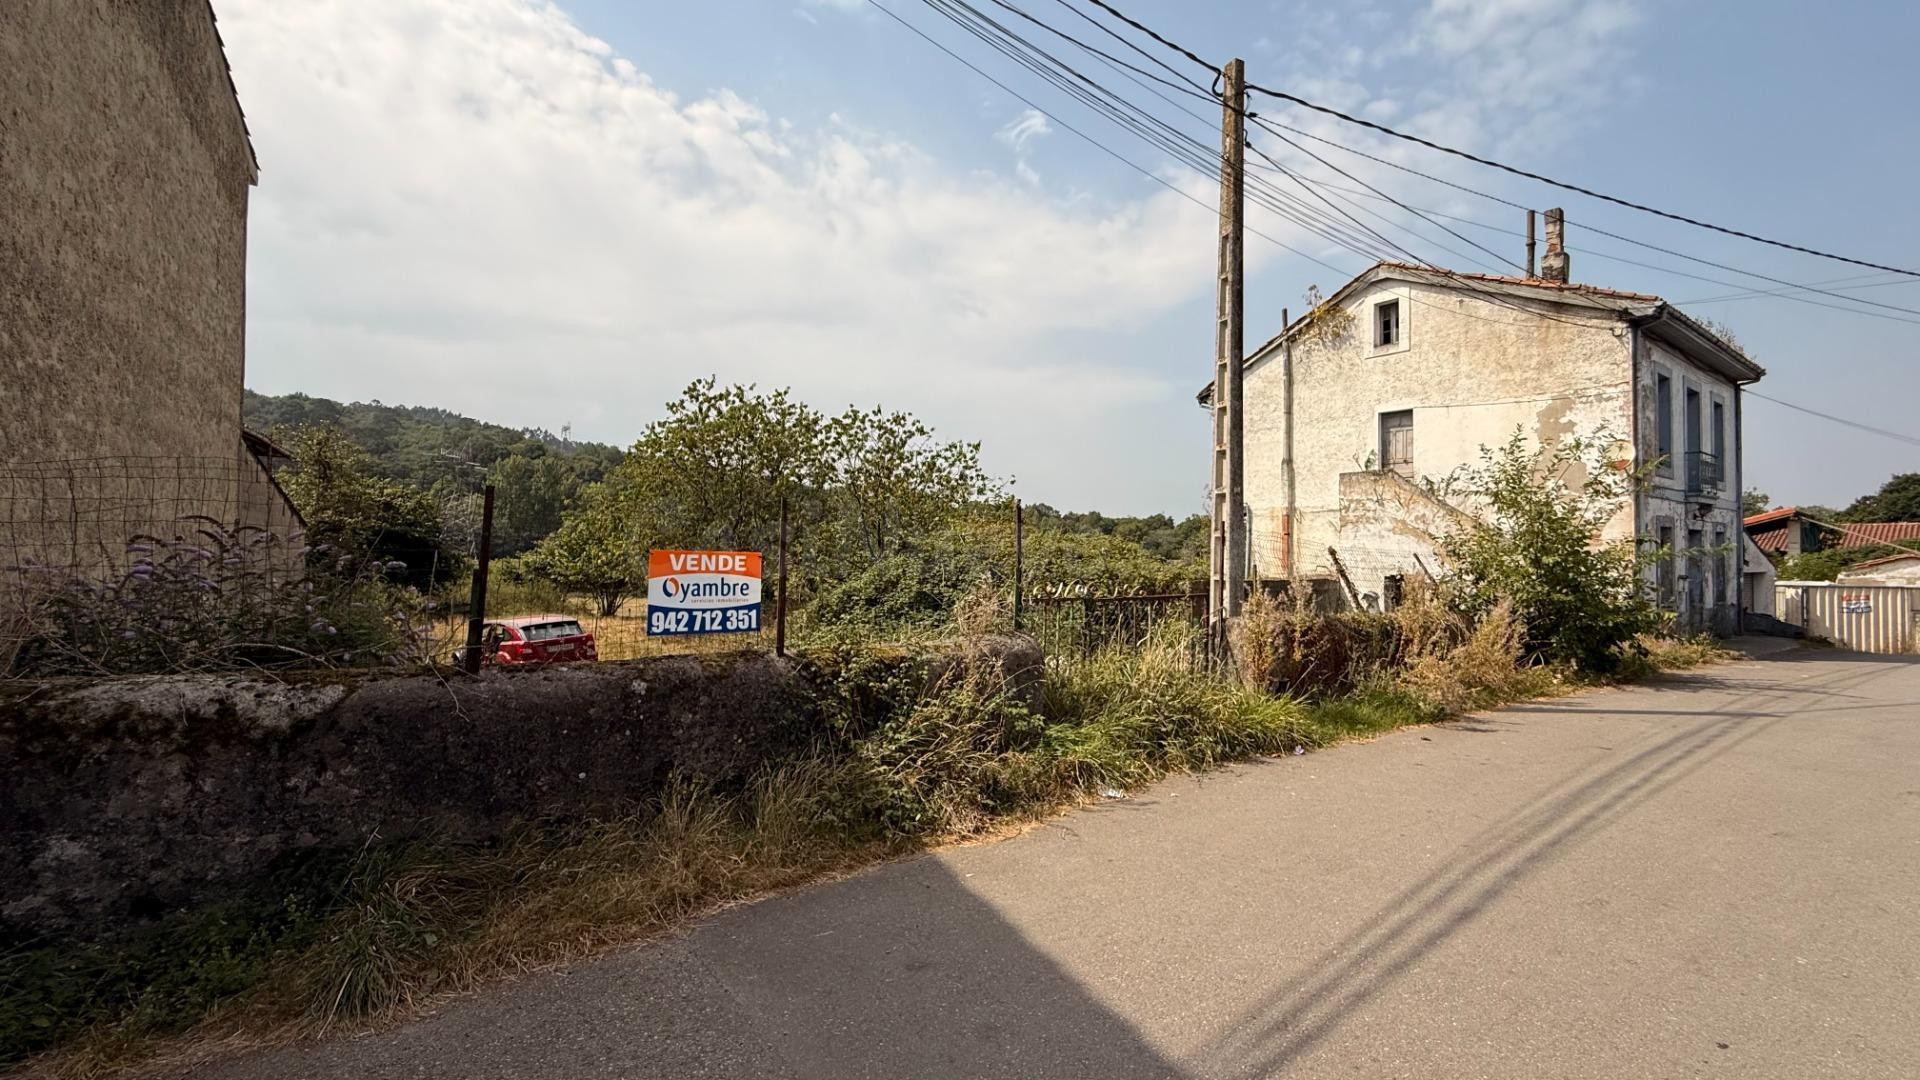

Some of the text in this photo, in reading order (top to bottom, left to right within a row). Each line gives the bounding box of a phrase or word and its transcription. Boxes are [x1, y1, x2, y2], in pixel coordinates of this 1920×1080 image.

[669, 554, 747, 571] VENDE
[662, 577, 750, 603] Oyambre
[651, 609, 757, 633] 942 712 351
